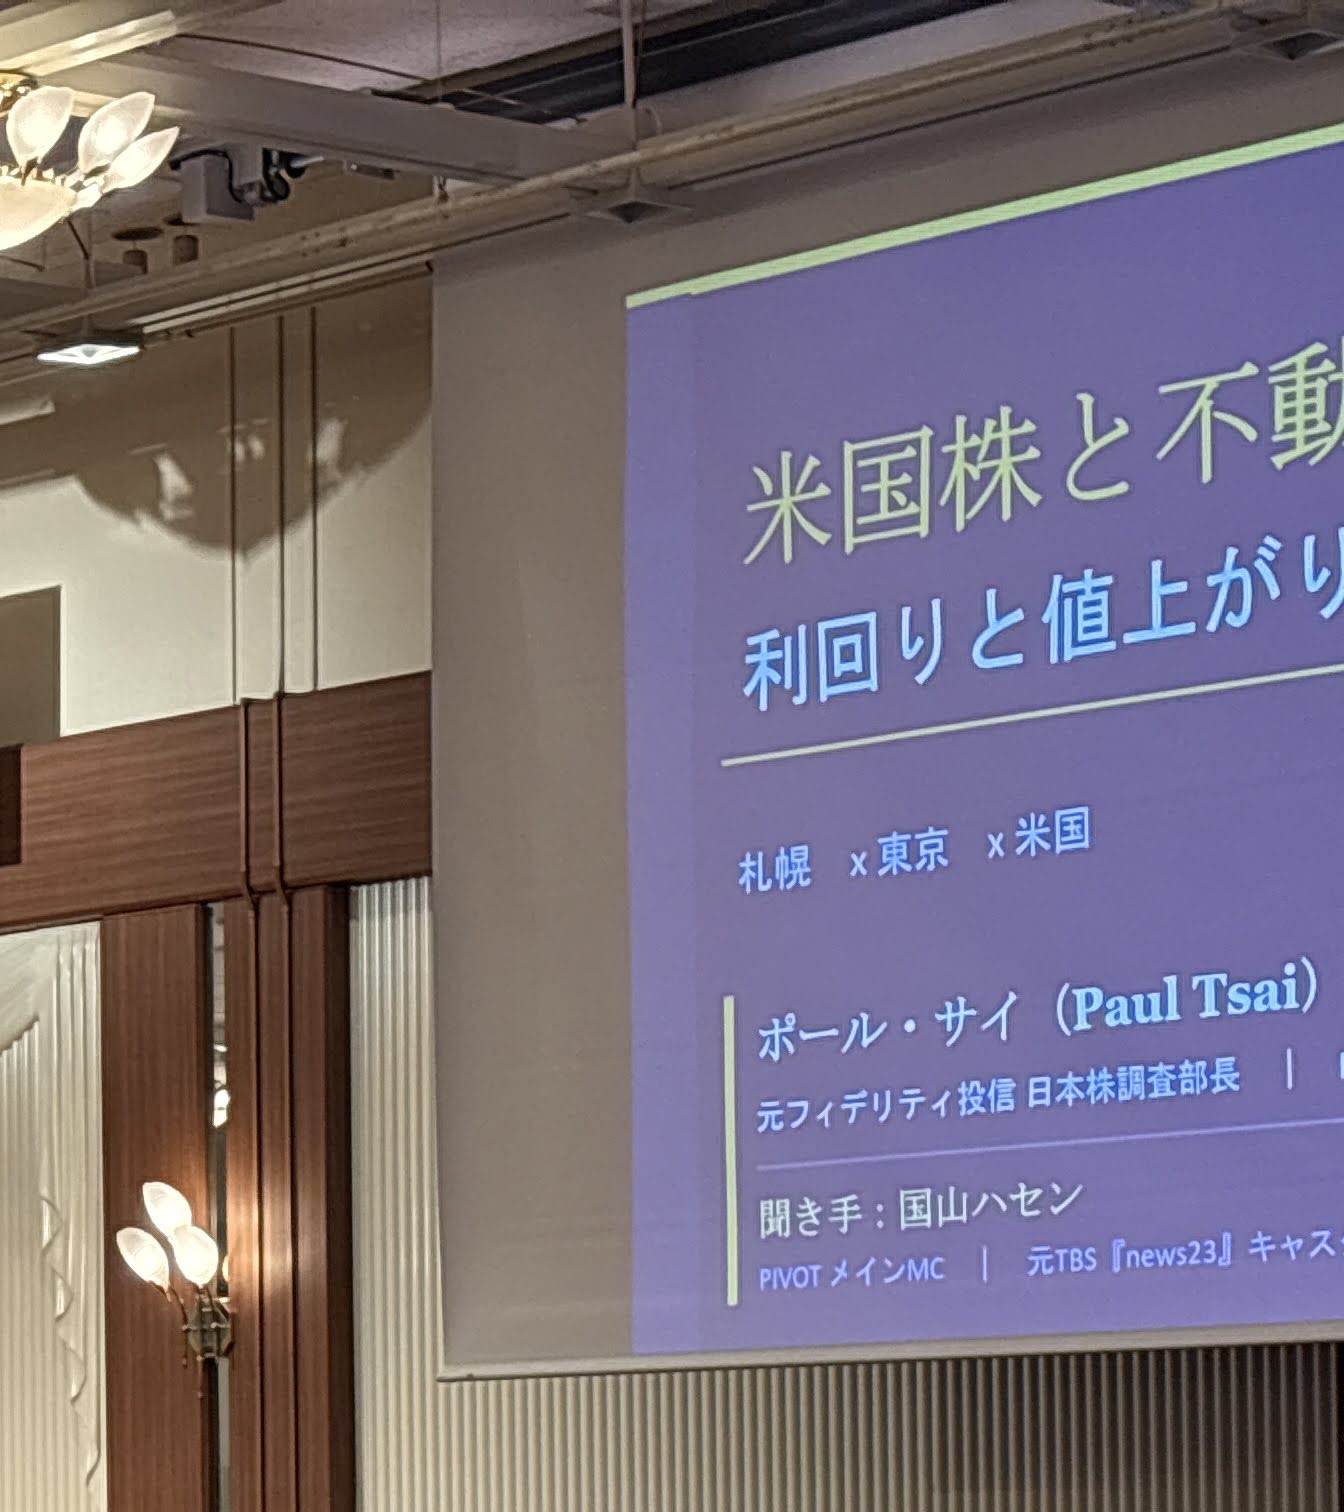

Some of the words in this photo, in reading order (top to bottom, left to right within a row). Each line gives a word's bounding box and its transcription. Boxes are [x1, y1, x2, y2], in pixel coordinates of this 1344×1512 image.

[743, 526, 1344, 712] 利回りと値上がり
[739, 845, 812, 894] 札幌
